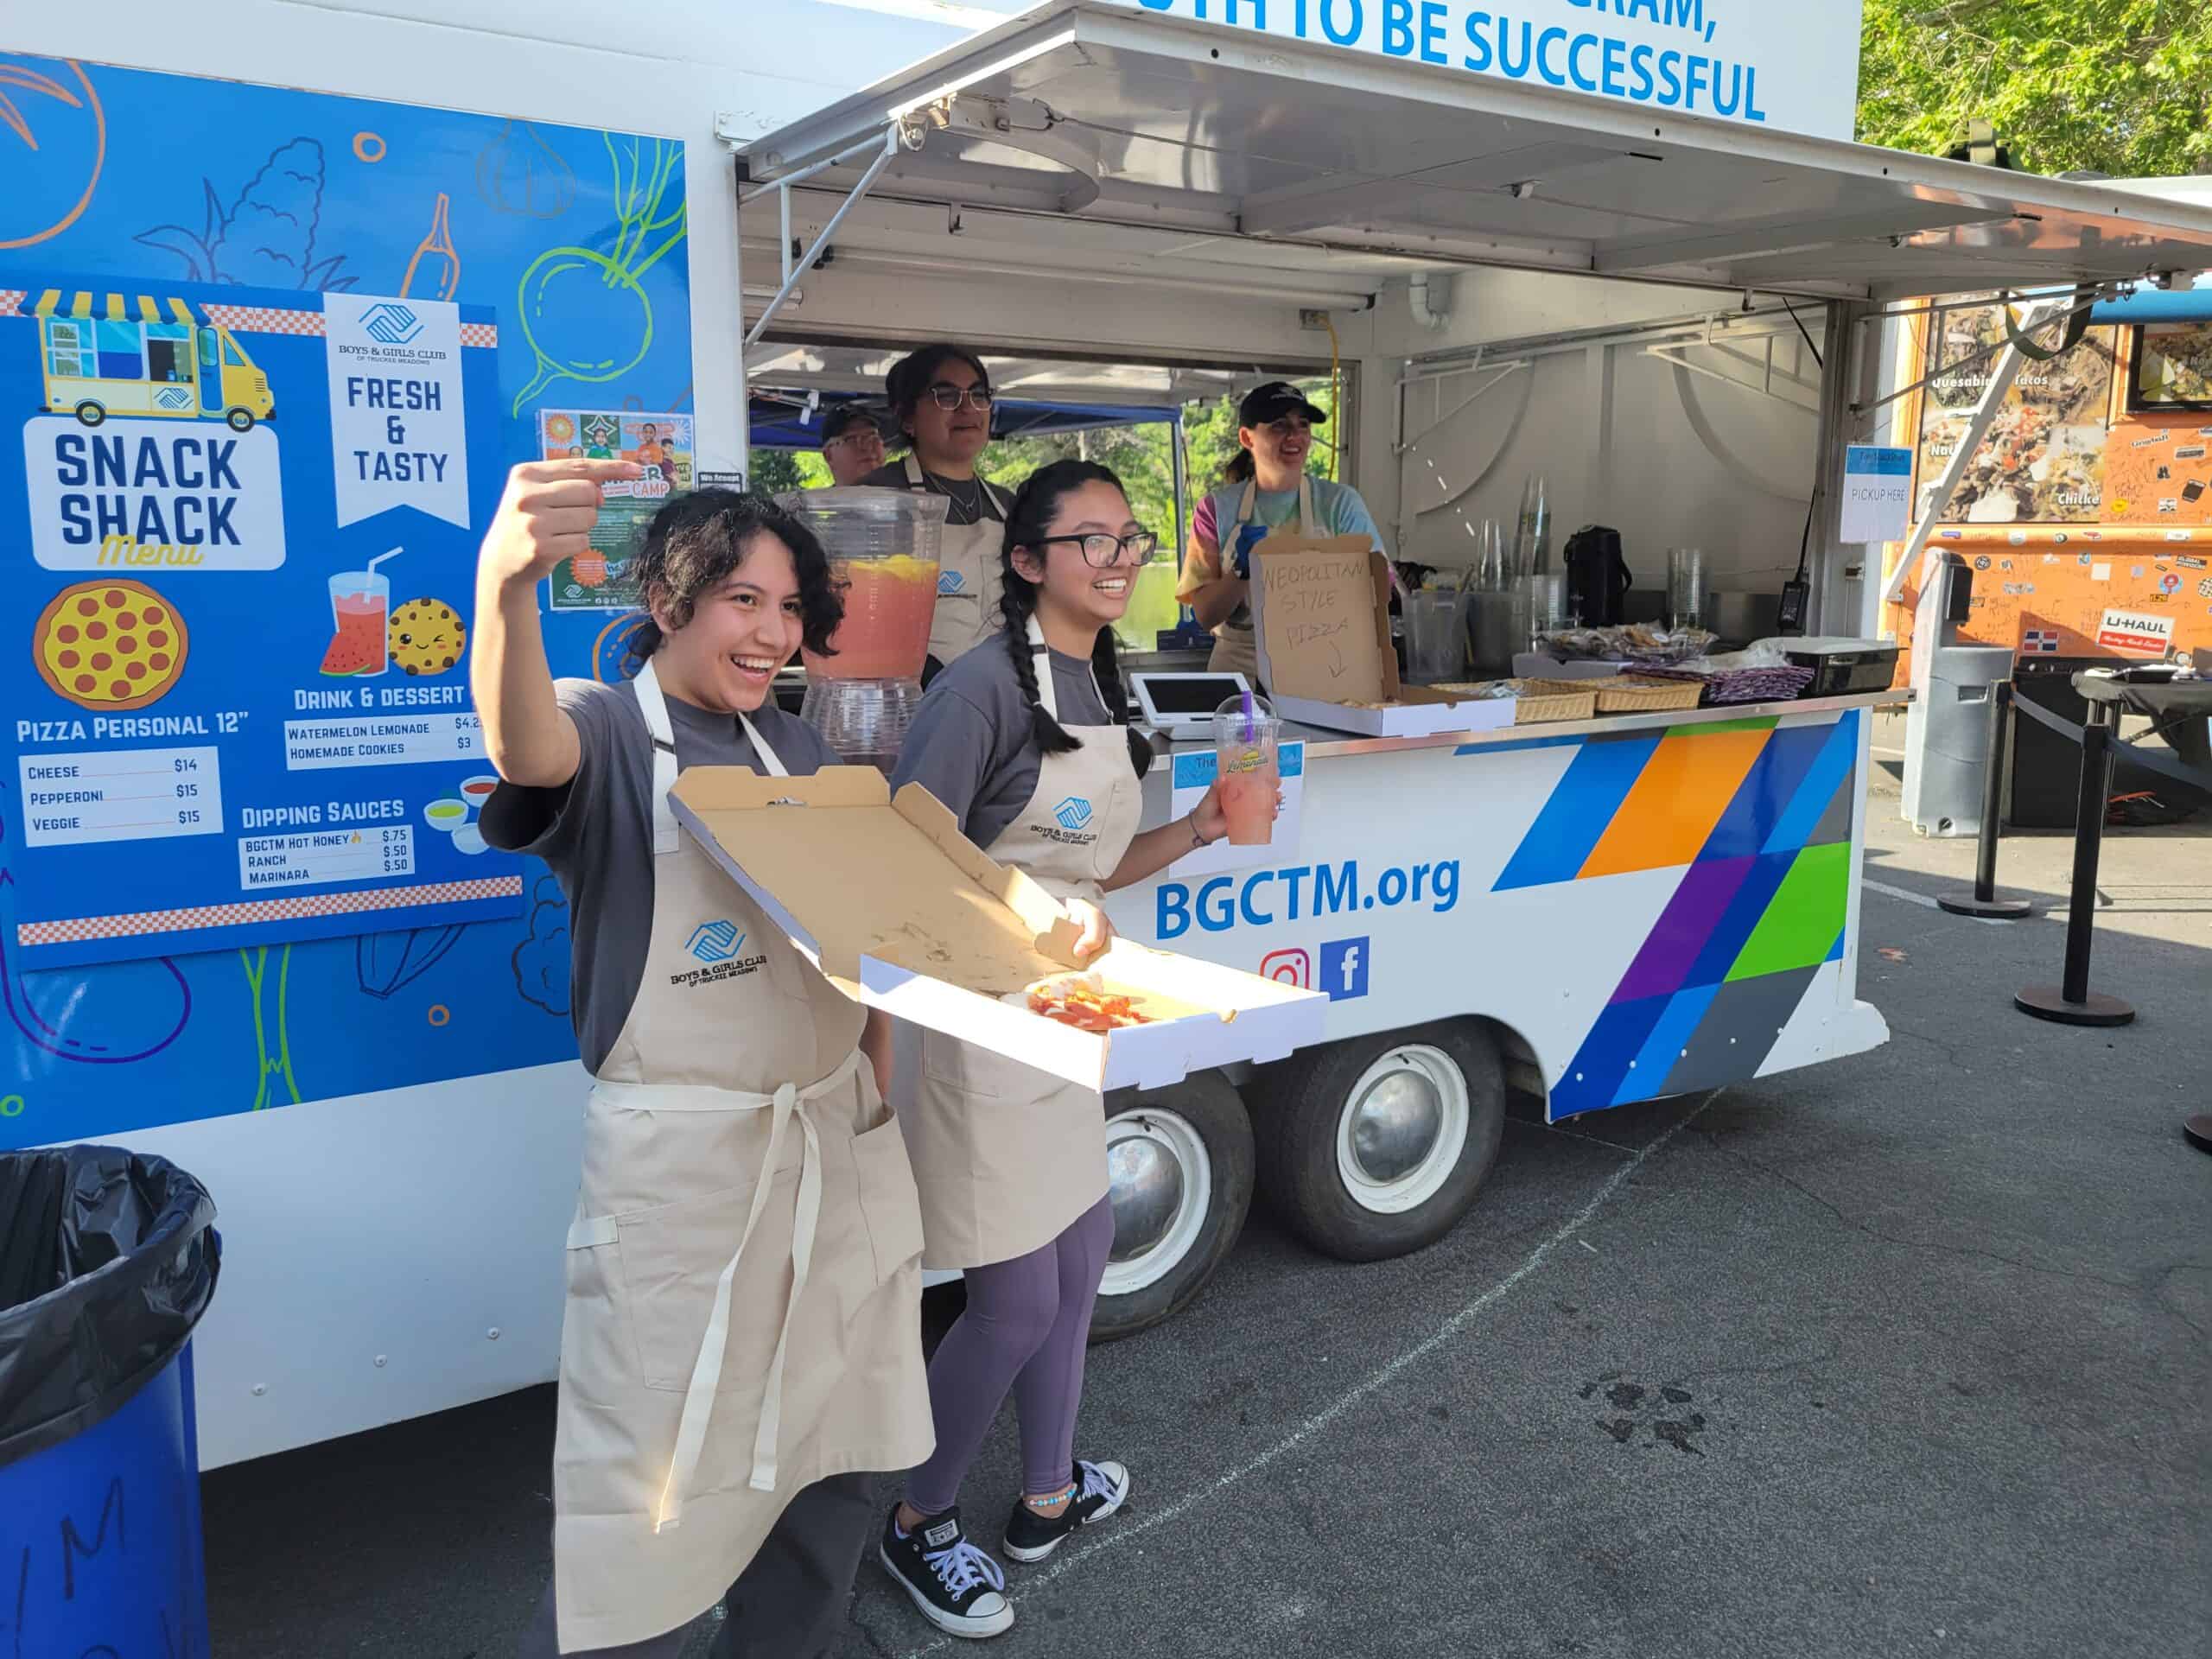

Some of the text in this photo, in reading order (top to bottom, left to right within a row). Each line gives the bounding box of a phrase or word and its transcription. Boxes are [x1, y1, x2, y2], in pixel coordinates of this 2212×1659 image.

[1382, 0, 1447, 64] BE
[1465, 11, 1765, 121] SUCCESSFUL
[338, 345, 447, 360] BOYS & GIRLS CLUB
[2014, 375, 2048, 386] Tacos
[347, 376, 442, 411] FRESH
[386, 415, 405, 444] &
[54, 433, 242, 490] SNACK
[353, 450, 448, 483] TASTY
[632, 482, 668, 498] CAMP
[1852, 488, 1906, 501] PICKUP HERE
[2057, 493, 2102, 505] Chicke
[60, 493, 242, 546] SHACK
[97, 534, 204, 566] Menu
[2106, 615, 2166, 634] U-HAUL
[294, 685, 465, 710] DRINK & DESSERT
[16, 720, 87, 743] PIZZA
[92, 715, 209, 739] PERSONAL
[454, 716, 483, 730] $4.2
[288, 723, 430, 741] WATERMELON LEMONADE
[456, 737, 471, 749] $3
[290, 743, 405, 760] HOMEMADE COOKIES
[174, 759, 198, 772] $14
[1196, 757, 1217, 769] The
[28, 766, 79, 780] CHEESE
[30, 790, 104, 806] PEPPERONI
[176, 784, 198, 798] $15
[178, 810, 200, 824] $15
[242, 799, 405, 830] DIPPING SAUCES
[33, 817, 80, 831] VEGGIE
[245, 834, 349, 853] BGCTM HOT HONEY
[382, 828, 407, 843] $.75
[383, 844, 408, 858] $.50
[248, 855, 287, 868] RANCH
[384, 858, 408, 873] $.50
[249, 868, 310, 884] MARINARA
[1156, 859, 1460, 940] BGCTM.org
[671, 969, 699, 985] BOYS
[701, 968, 711, 977] &
[712, 960, 743, 975] GIRLS
